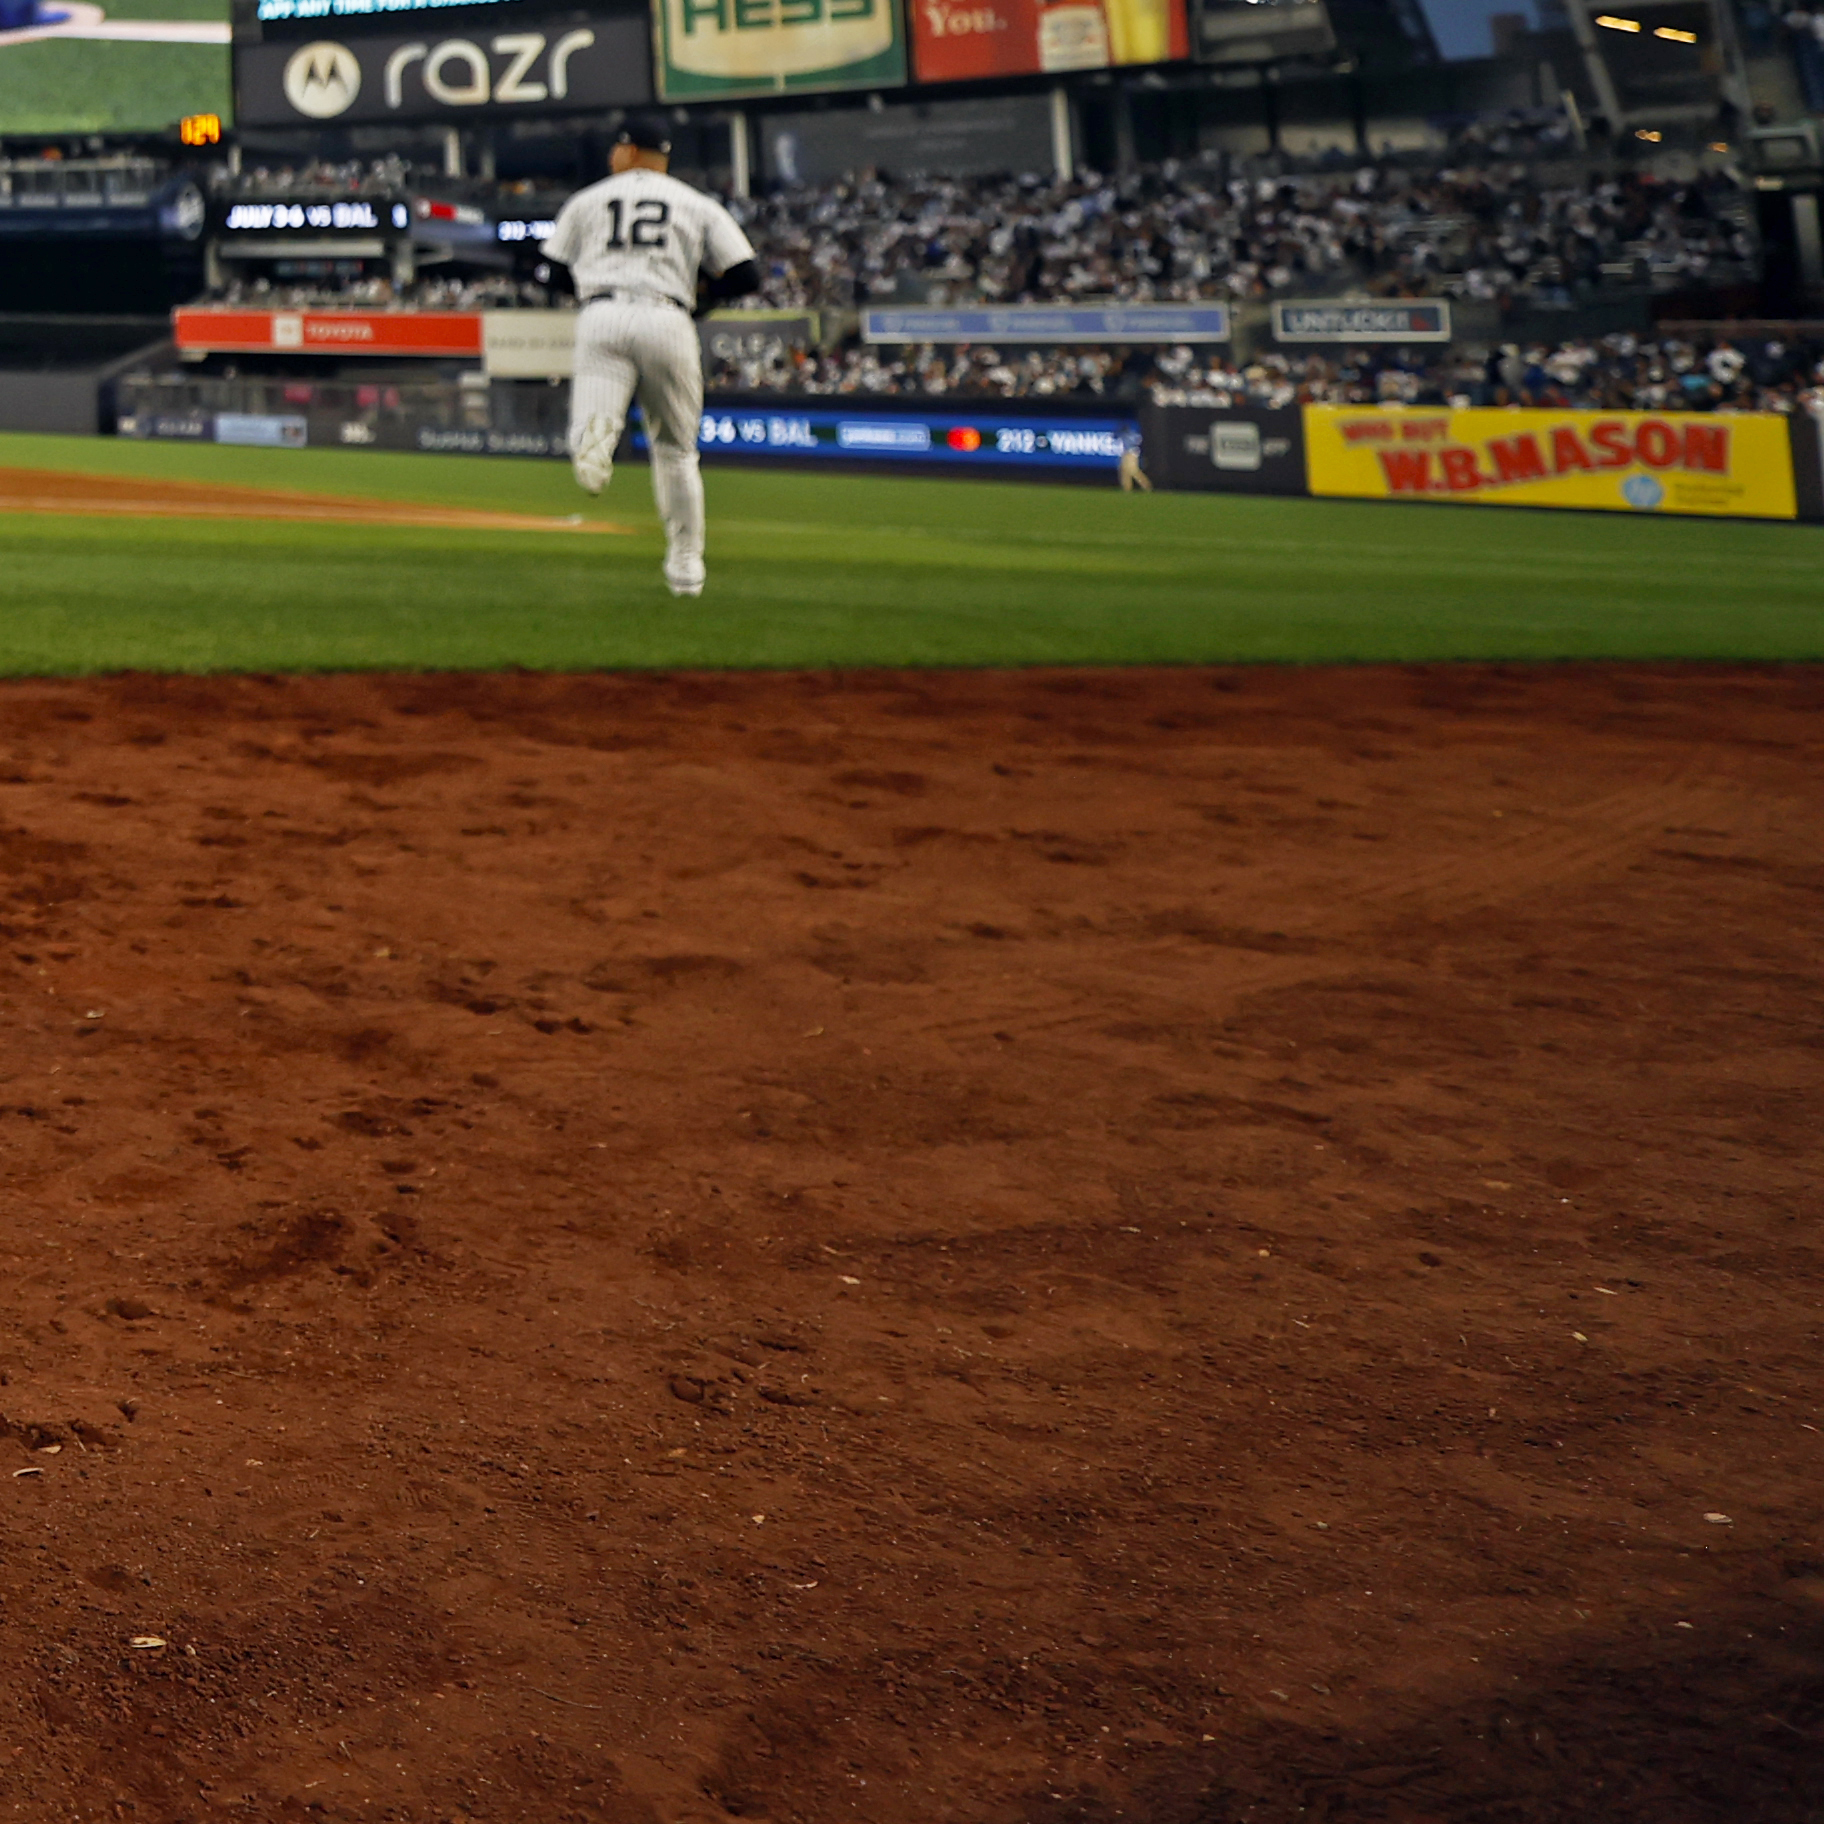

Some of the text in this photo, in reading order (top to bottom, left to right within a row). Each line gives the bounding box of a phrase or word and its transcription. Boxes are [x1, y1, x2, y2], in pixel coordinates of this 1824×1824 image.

[925, 4, 1008, 38] You.
[383, 28, 596, 109] razr
[226, 204, 273, 228] JULY
[272, 204, 305, 228] 3-6
[333, 202, 378, 228] BAL
[606, 198, 670, 250] 12
[767, 416, 819, 447] BAL
